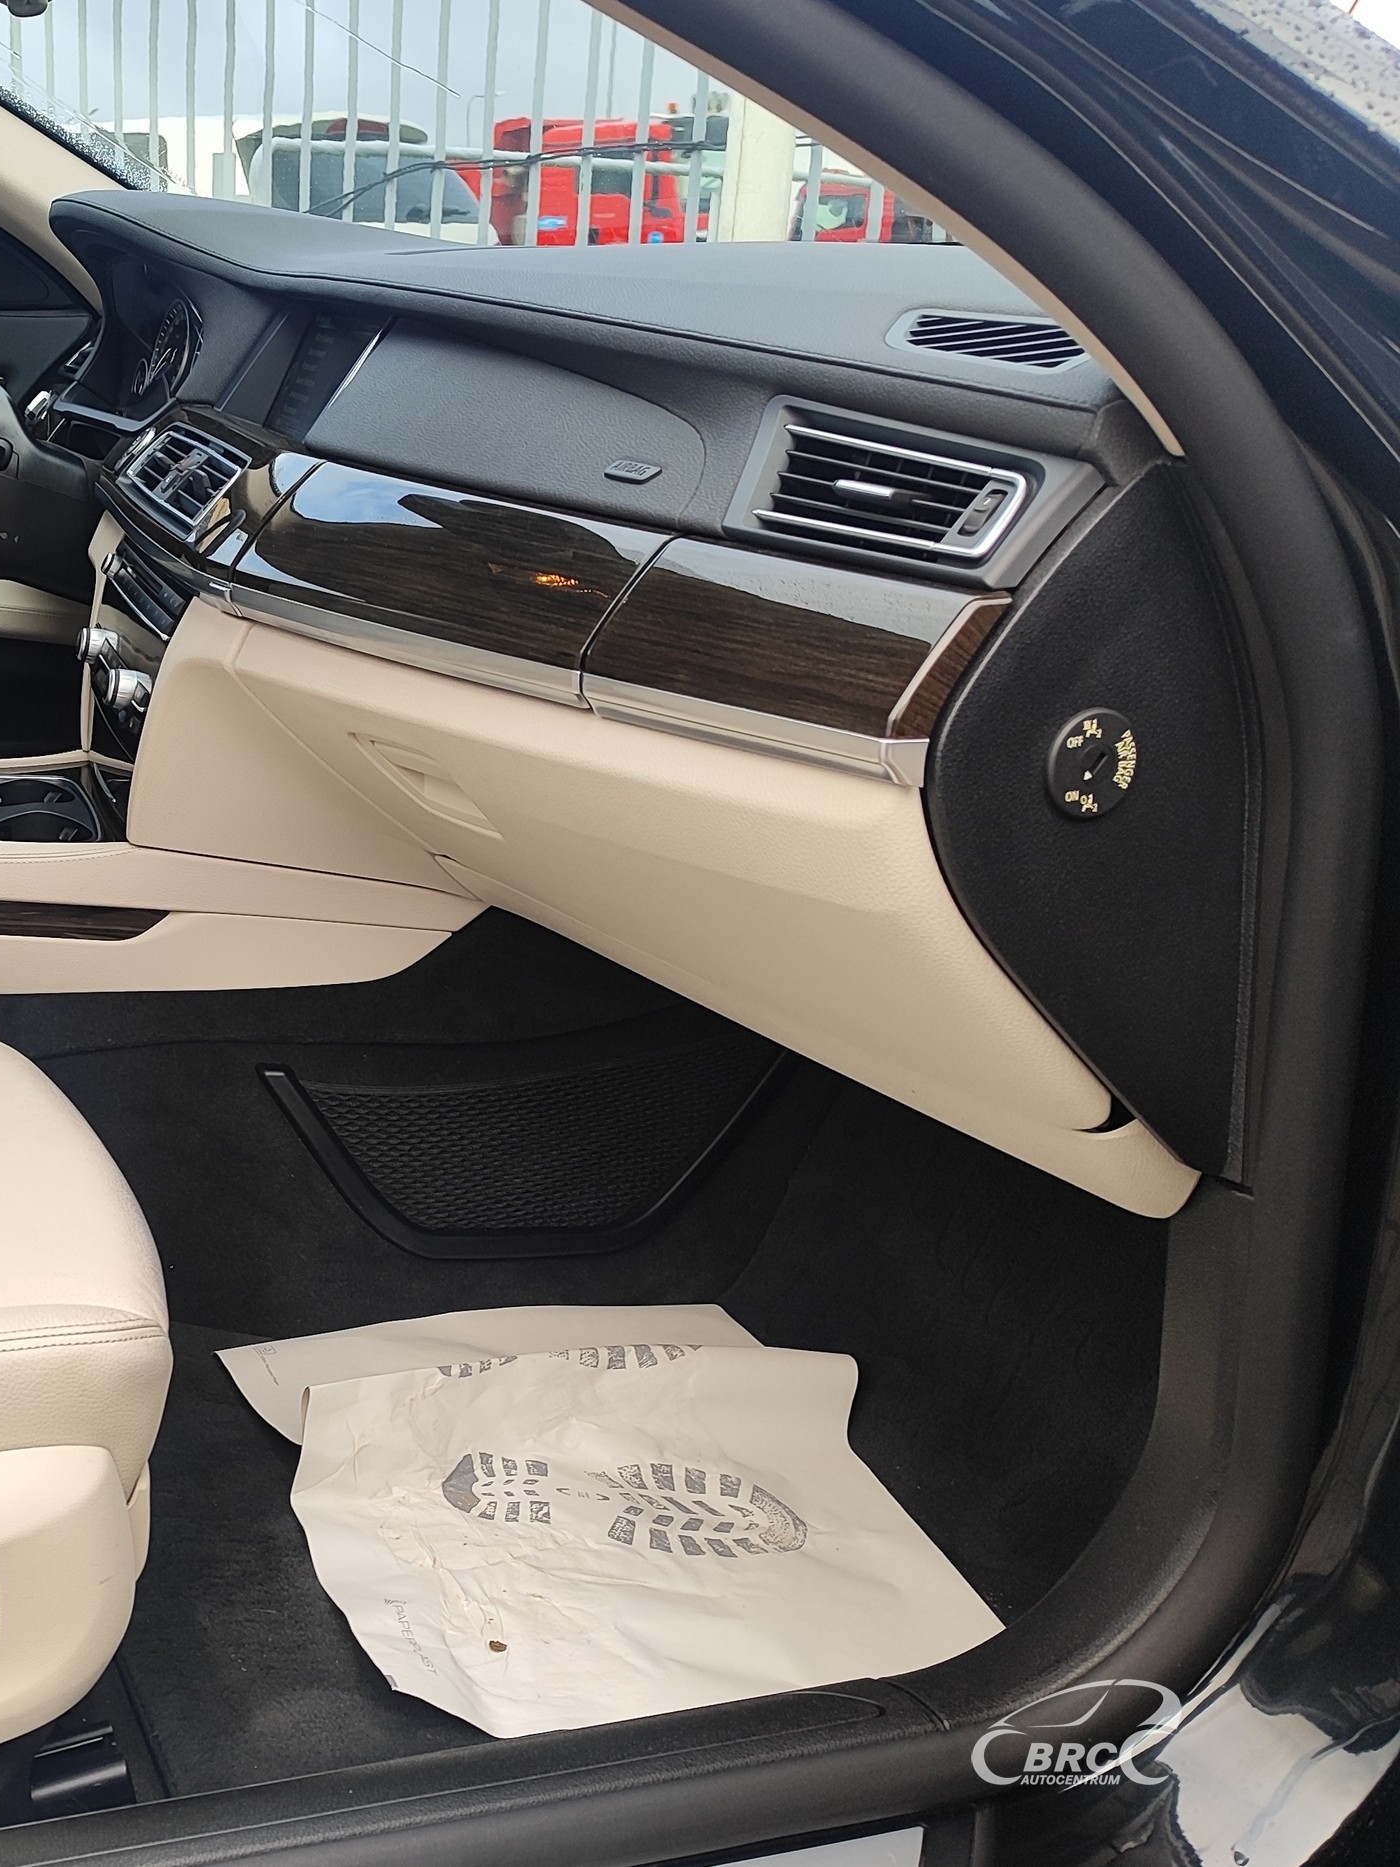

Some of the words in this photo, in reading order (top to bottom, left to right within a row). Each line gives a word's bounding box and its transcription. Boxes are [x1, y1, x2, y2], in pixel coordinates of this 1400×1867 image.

[610, 461, 651, 476] AIRBAG
[1066, 735, 1084, 749] OFF
[1117, 729, 1137, 789] PASSENGER
[1064, 789, 1080, 802] ON
